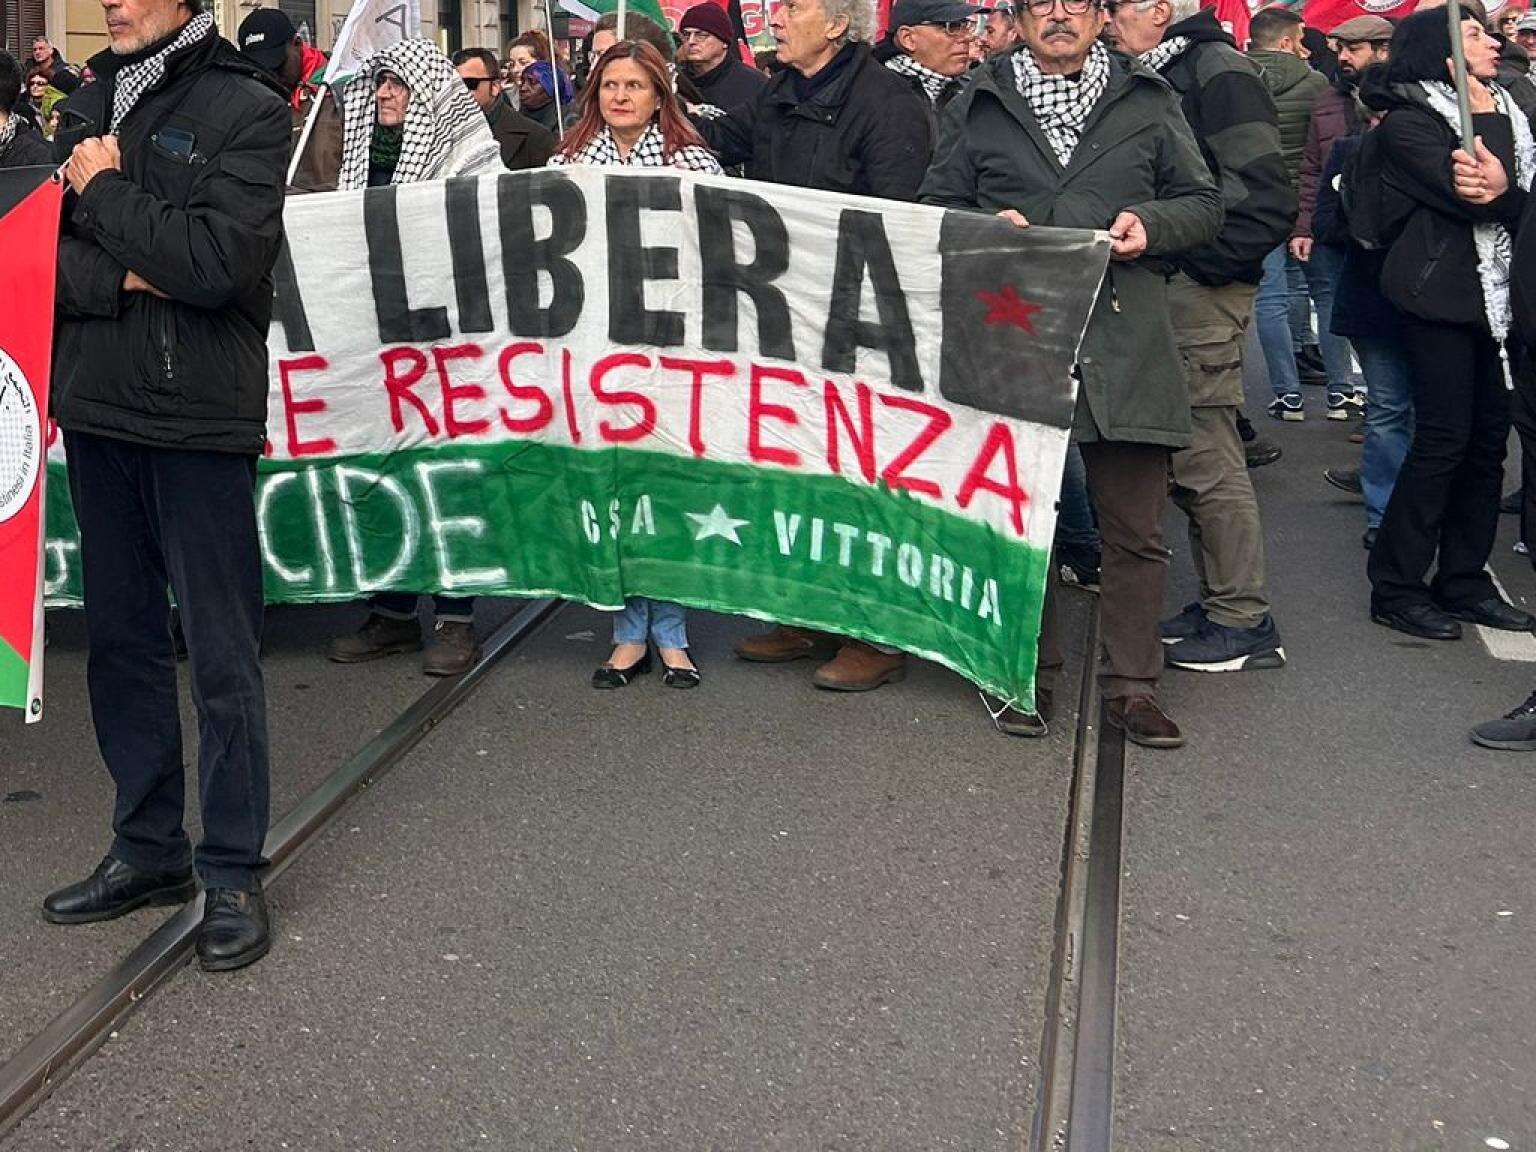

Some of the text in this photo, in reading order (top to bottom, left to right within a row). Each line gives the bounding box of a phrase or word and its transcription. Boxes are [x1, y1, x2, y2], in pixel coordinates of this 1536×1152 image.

[363, 171, 925, 392] LIBERA
[22, 461, 30, 477] in
[23, 425, 34, 460] Italia
[380, 341, 1030, 537] RESISTENZA
[580, 493, 1003, 628] CSA VITTORIA
